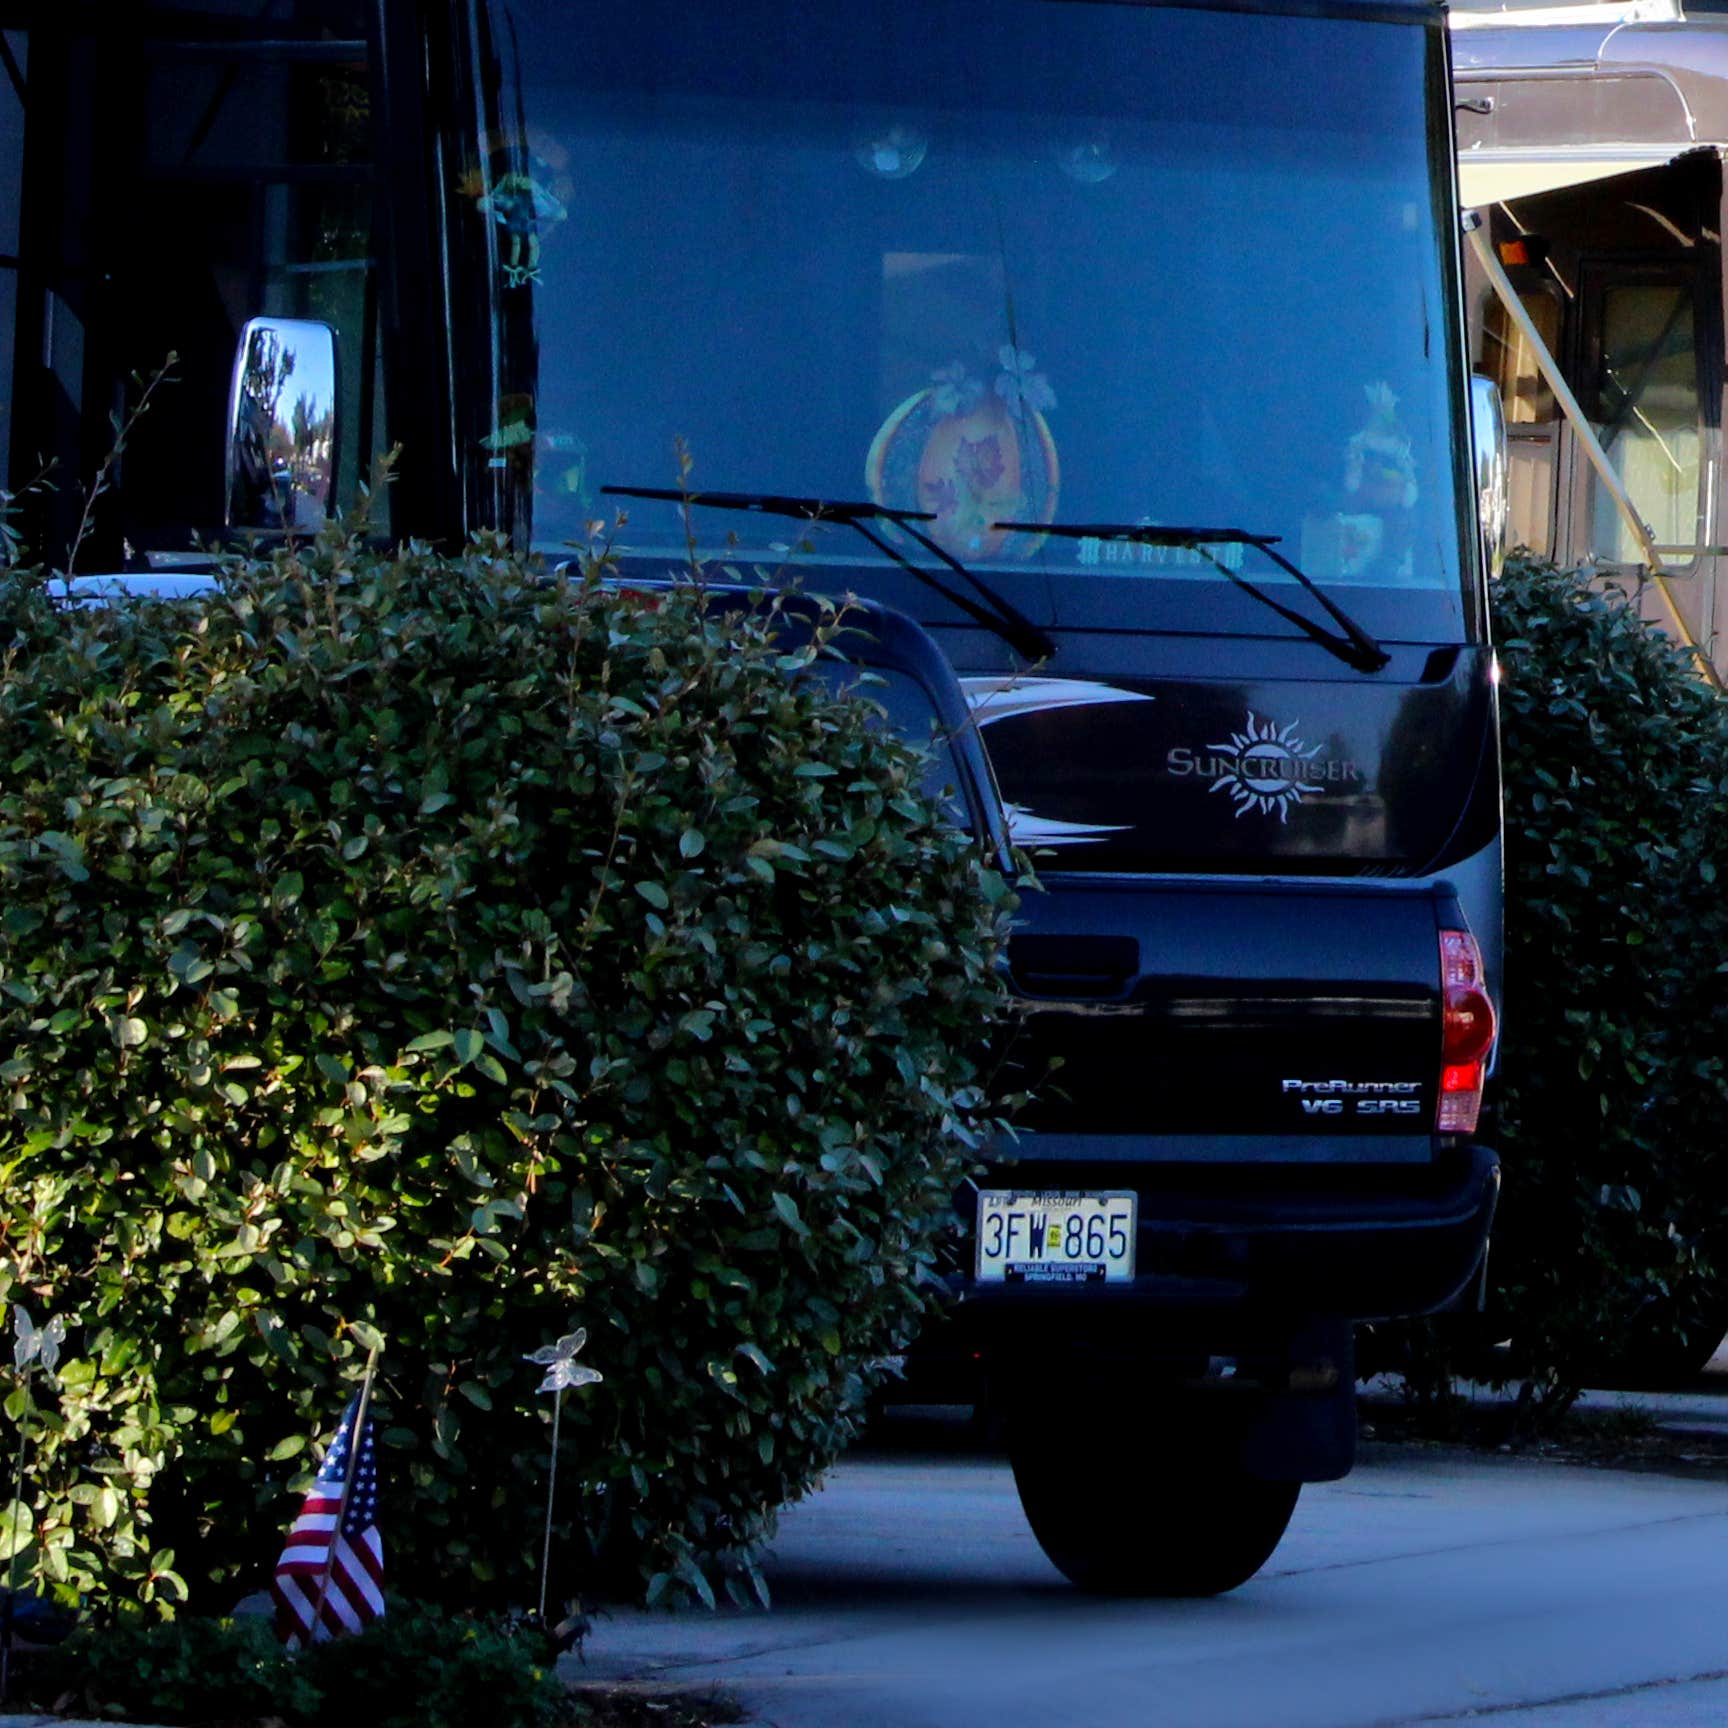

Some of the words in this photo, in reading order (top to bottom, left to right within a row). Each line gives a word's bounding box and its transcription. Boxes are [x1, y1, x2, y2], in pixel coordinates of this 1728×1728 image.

[1282, 1079, 1422, 1093] PreRunner
[1302, 1099, 1343, 1114] V6
[1357, 1099, 1420, 1114] SR5
[1031, 1196, 1082, 1207] Missouri
[985, 1212, 1047, 1258] 3FW
[1065, 1213, 1128, 1259] 865
